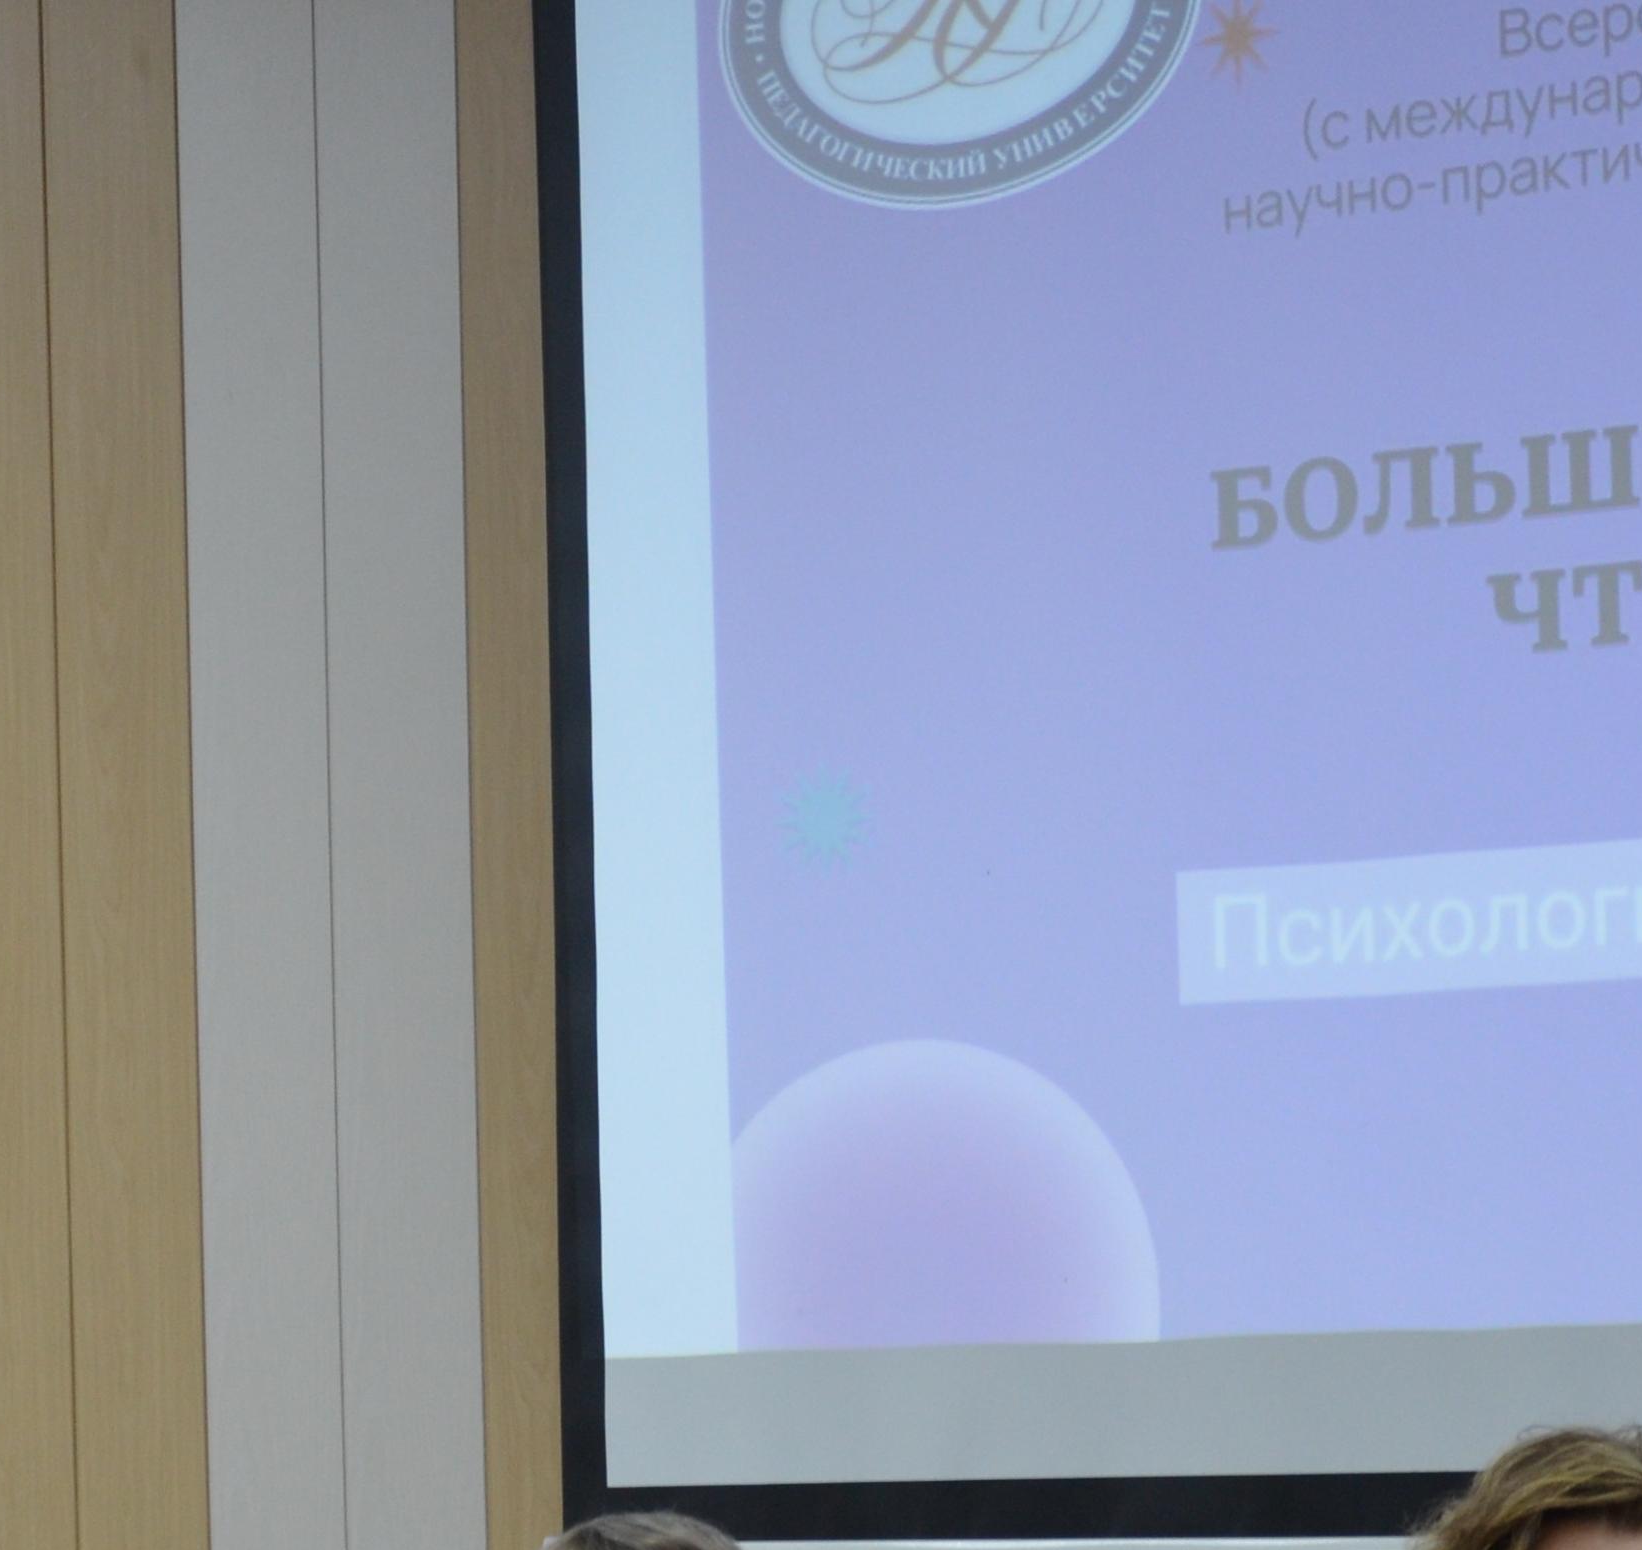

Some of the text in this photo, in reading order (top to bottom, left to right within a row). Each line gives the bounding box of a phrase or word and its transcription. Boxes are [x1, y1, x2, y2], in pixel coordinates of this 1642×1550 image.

[757, 69, 987, 181] ПЕДАГОГИЧЕСКИЙ
[993, 0, 1171, 170] УНИВЕРСИТЕТ
[1302, 97, 1350, 161] (с
